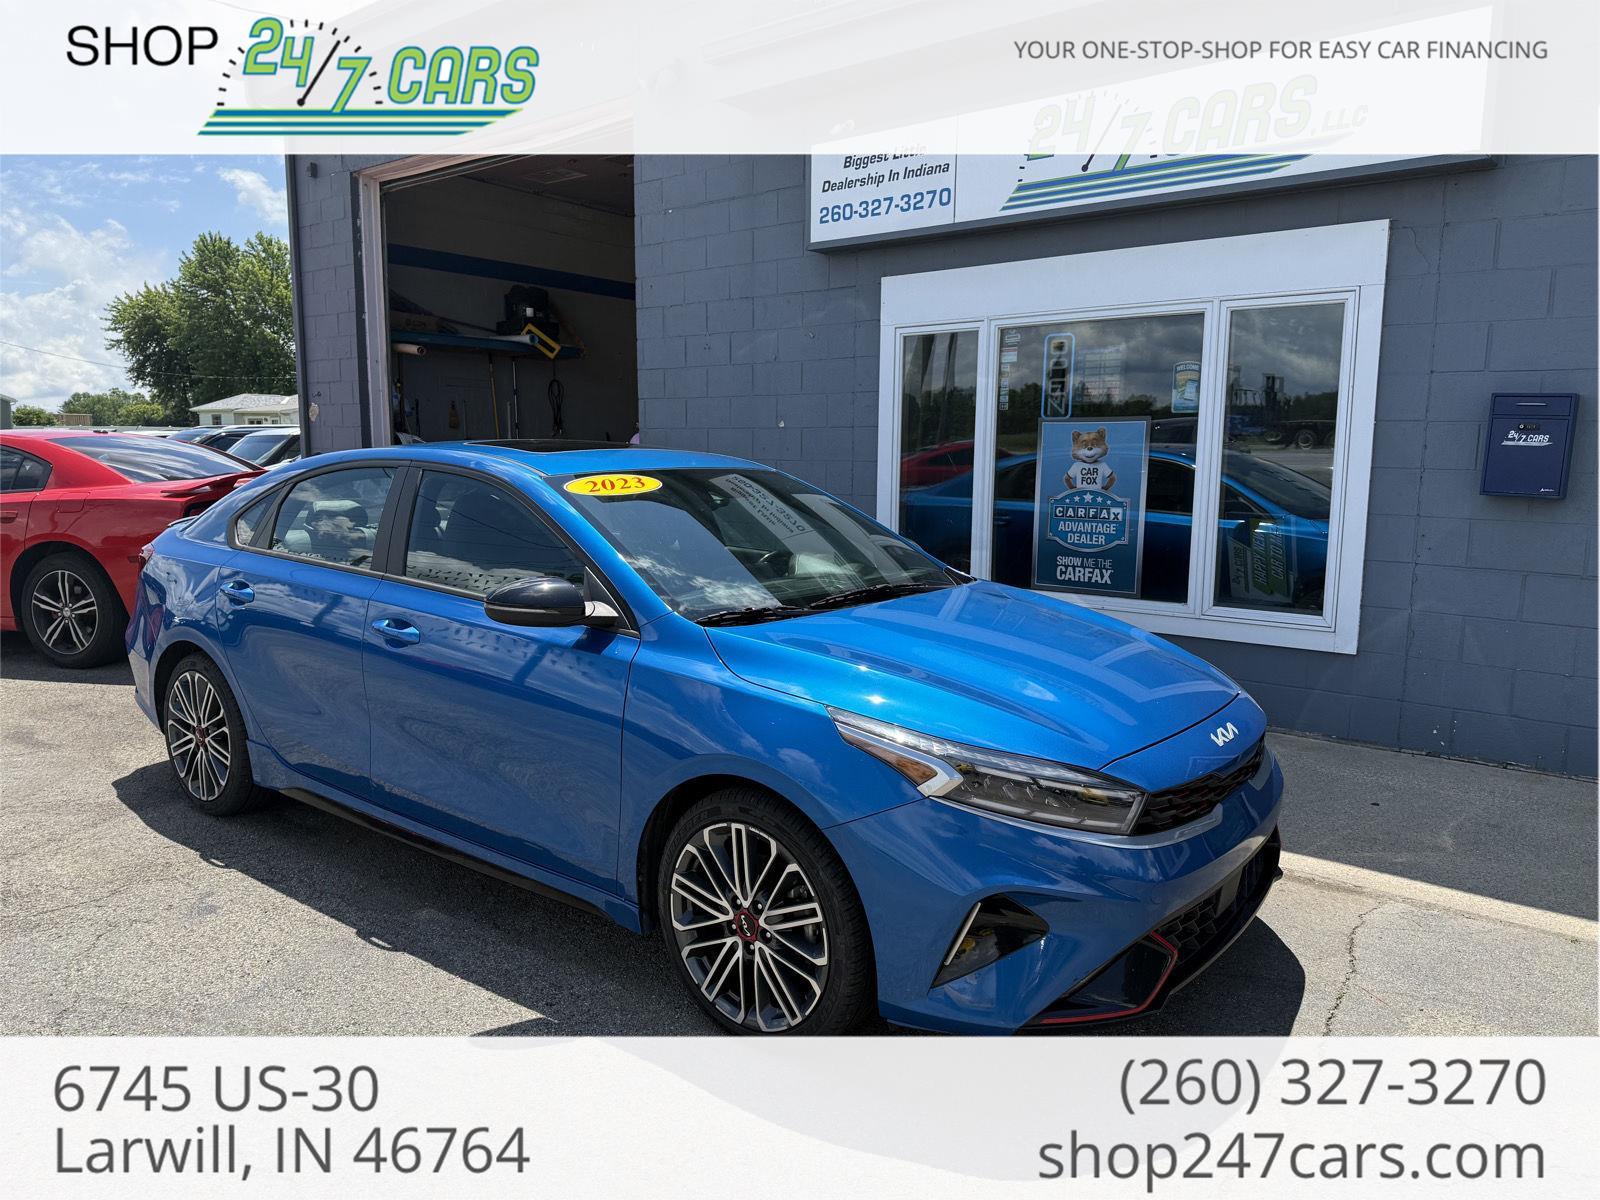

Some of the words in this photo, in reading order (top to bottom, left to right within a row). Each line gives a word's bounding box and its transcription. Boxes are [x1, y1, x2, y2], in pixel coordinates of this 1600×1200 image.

[843, 151, 889, 170] Biggest
[822, 172, 885, 193] Dealership
[888, 169, 900, 182] In
[903, 162, 950, 180] Indiana
[819, 187, 952, 224] 260-327-3270
[1527, 434, 1550, 443] CARS
[1080, 467, 1099, 476] CAR
[585, 477, 646, 493] 2023
[1080, 476, 1098, 485] FOX
[1055, 506, 1121, 520] CARFAX
[1058, 521, 1117, 534] ADVANTAGE
[1067, 533, 1105, 545] DEALER
[1056, 555, 1082, 566] SHOW
[1083, 557, 1095, 567] ME
[1096, 558, 1113, 569] THE
[1252, 552, 1268, 585] HAPPY
[1056, 566, 1113, 584] CARFAX
